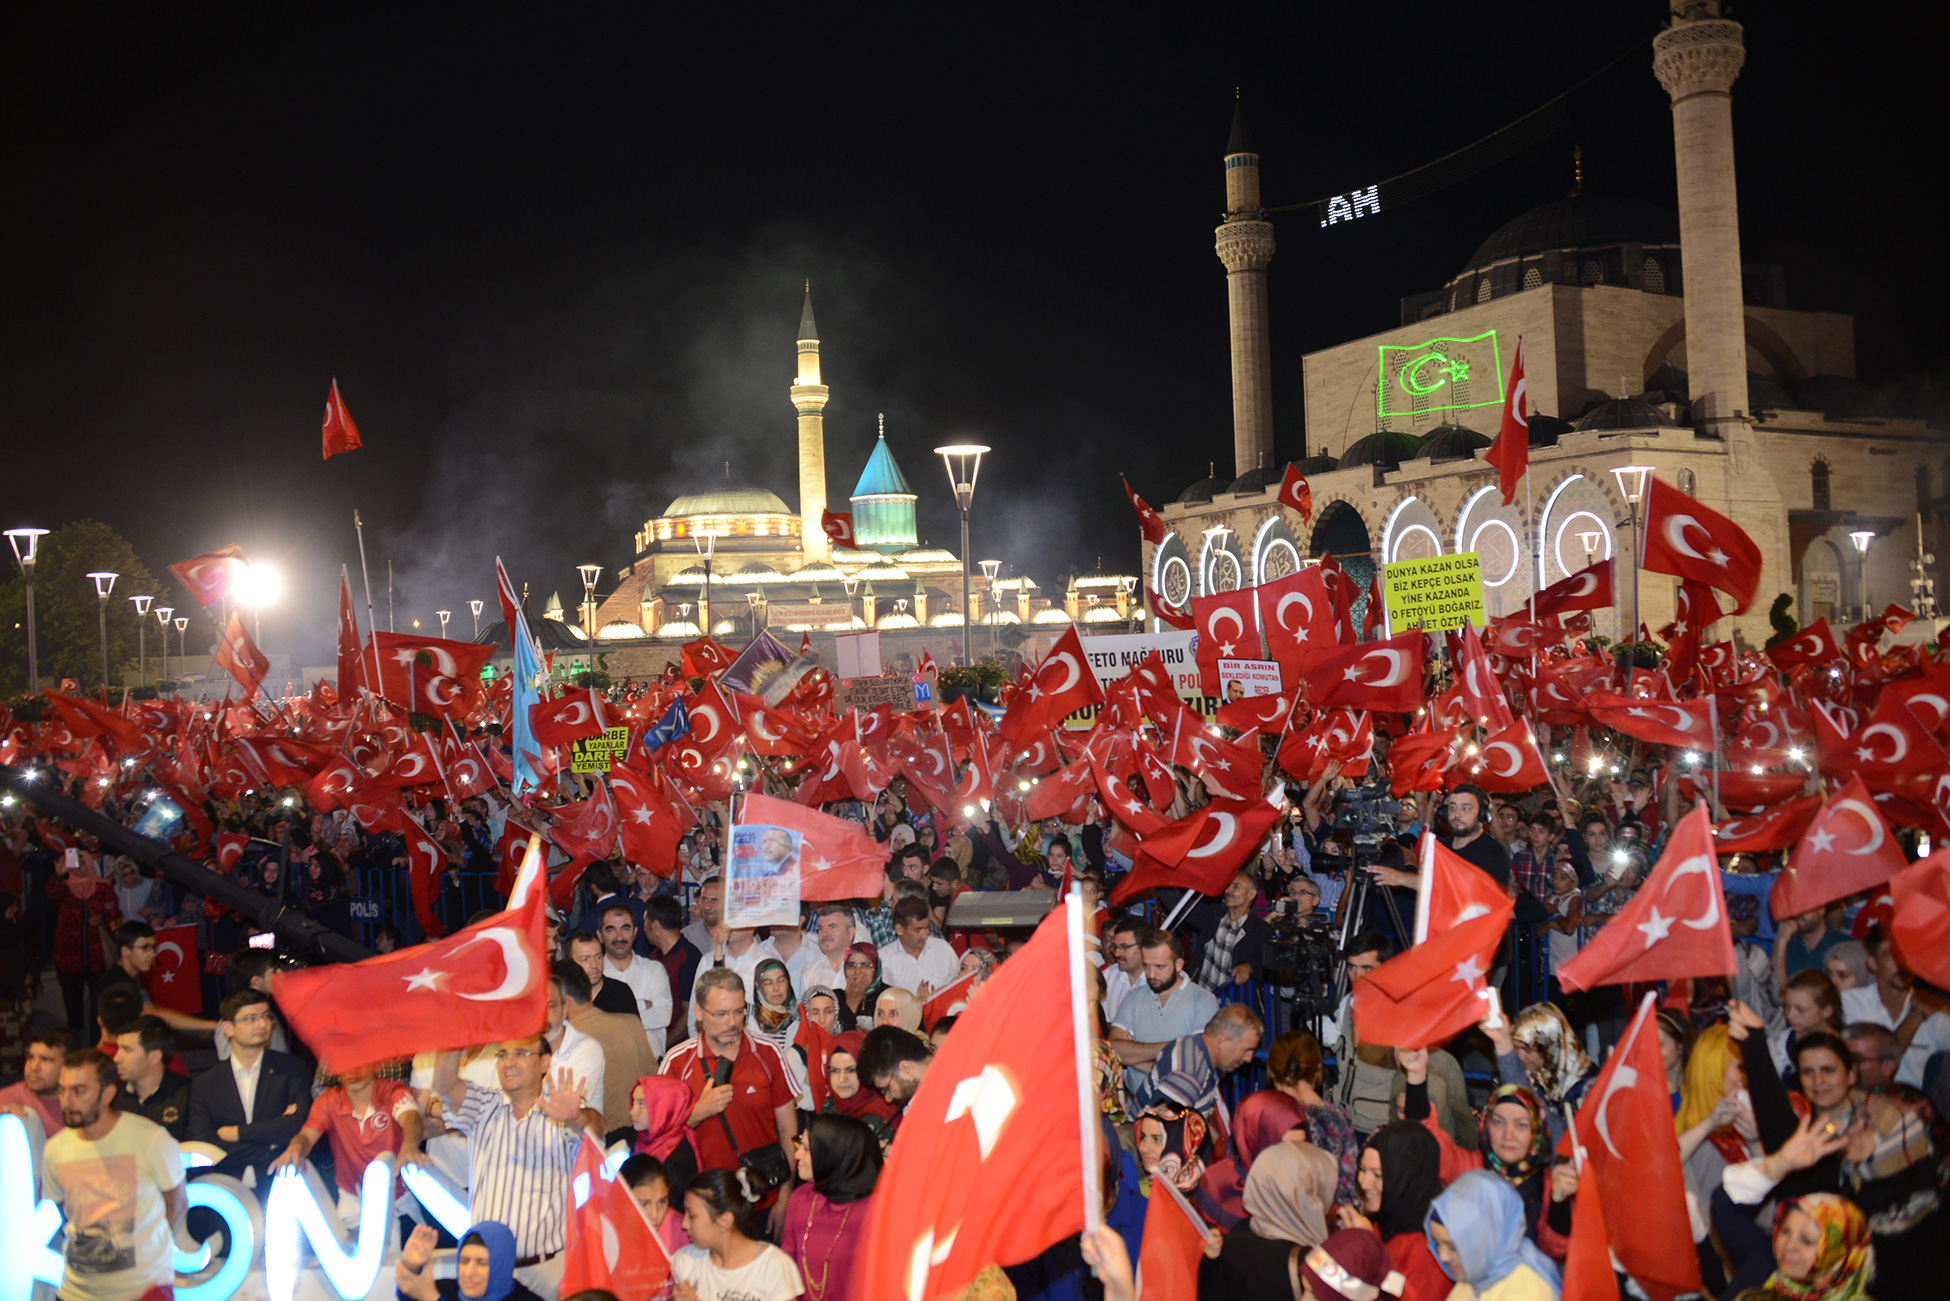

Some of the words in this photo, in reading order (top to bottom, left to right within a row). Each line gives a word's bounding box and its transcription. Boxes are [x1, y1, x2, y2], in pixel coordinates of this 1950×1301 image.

[1387, 567, 1418, 579] DÜNYA
[1420, 562, 1452, 574] KAZAN
[1454, 558, 1479, 570] OLSA
[1393, 580, 1409, 592] BİZ
[1411, 577, 1441, 589] KEPÇE
[1444, 572, 1475, 585] OLSAK
[1401, 592, 1423, 604] YİNE
[1425, 587, 1470, 600] KAZANDA
[1391, 610, 1398, 619] O
[1438, 600, 1483, 614] BOĞARIZ.
[1440, 616, 1466, 627] ÖZTA
[1121, 646, 1184, 668] MAĞURU
[1223, 661, 1241, 669] BİR
[1244, 663, 1275, 671] ASRIN
[1179, 673, 1202, 689] POL
[588, 741, 625, 749] YAPANLAR
[350, 900, 379, 918] POLİS
